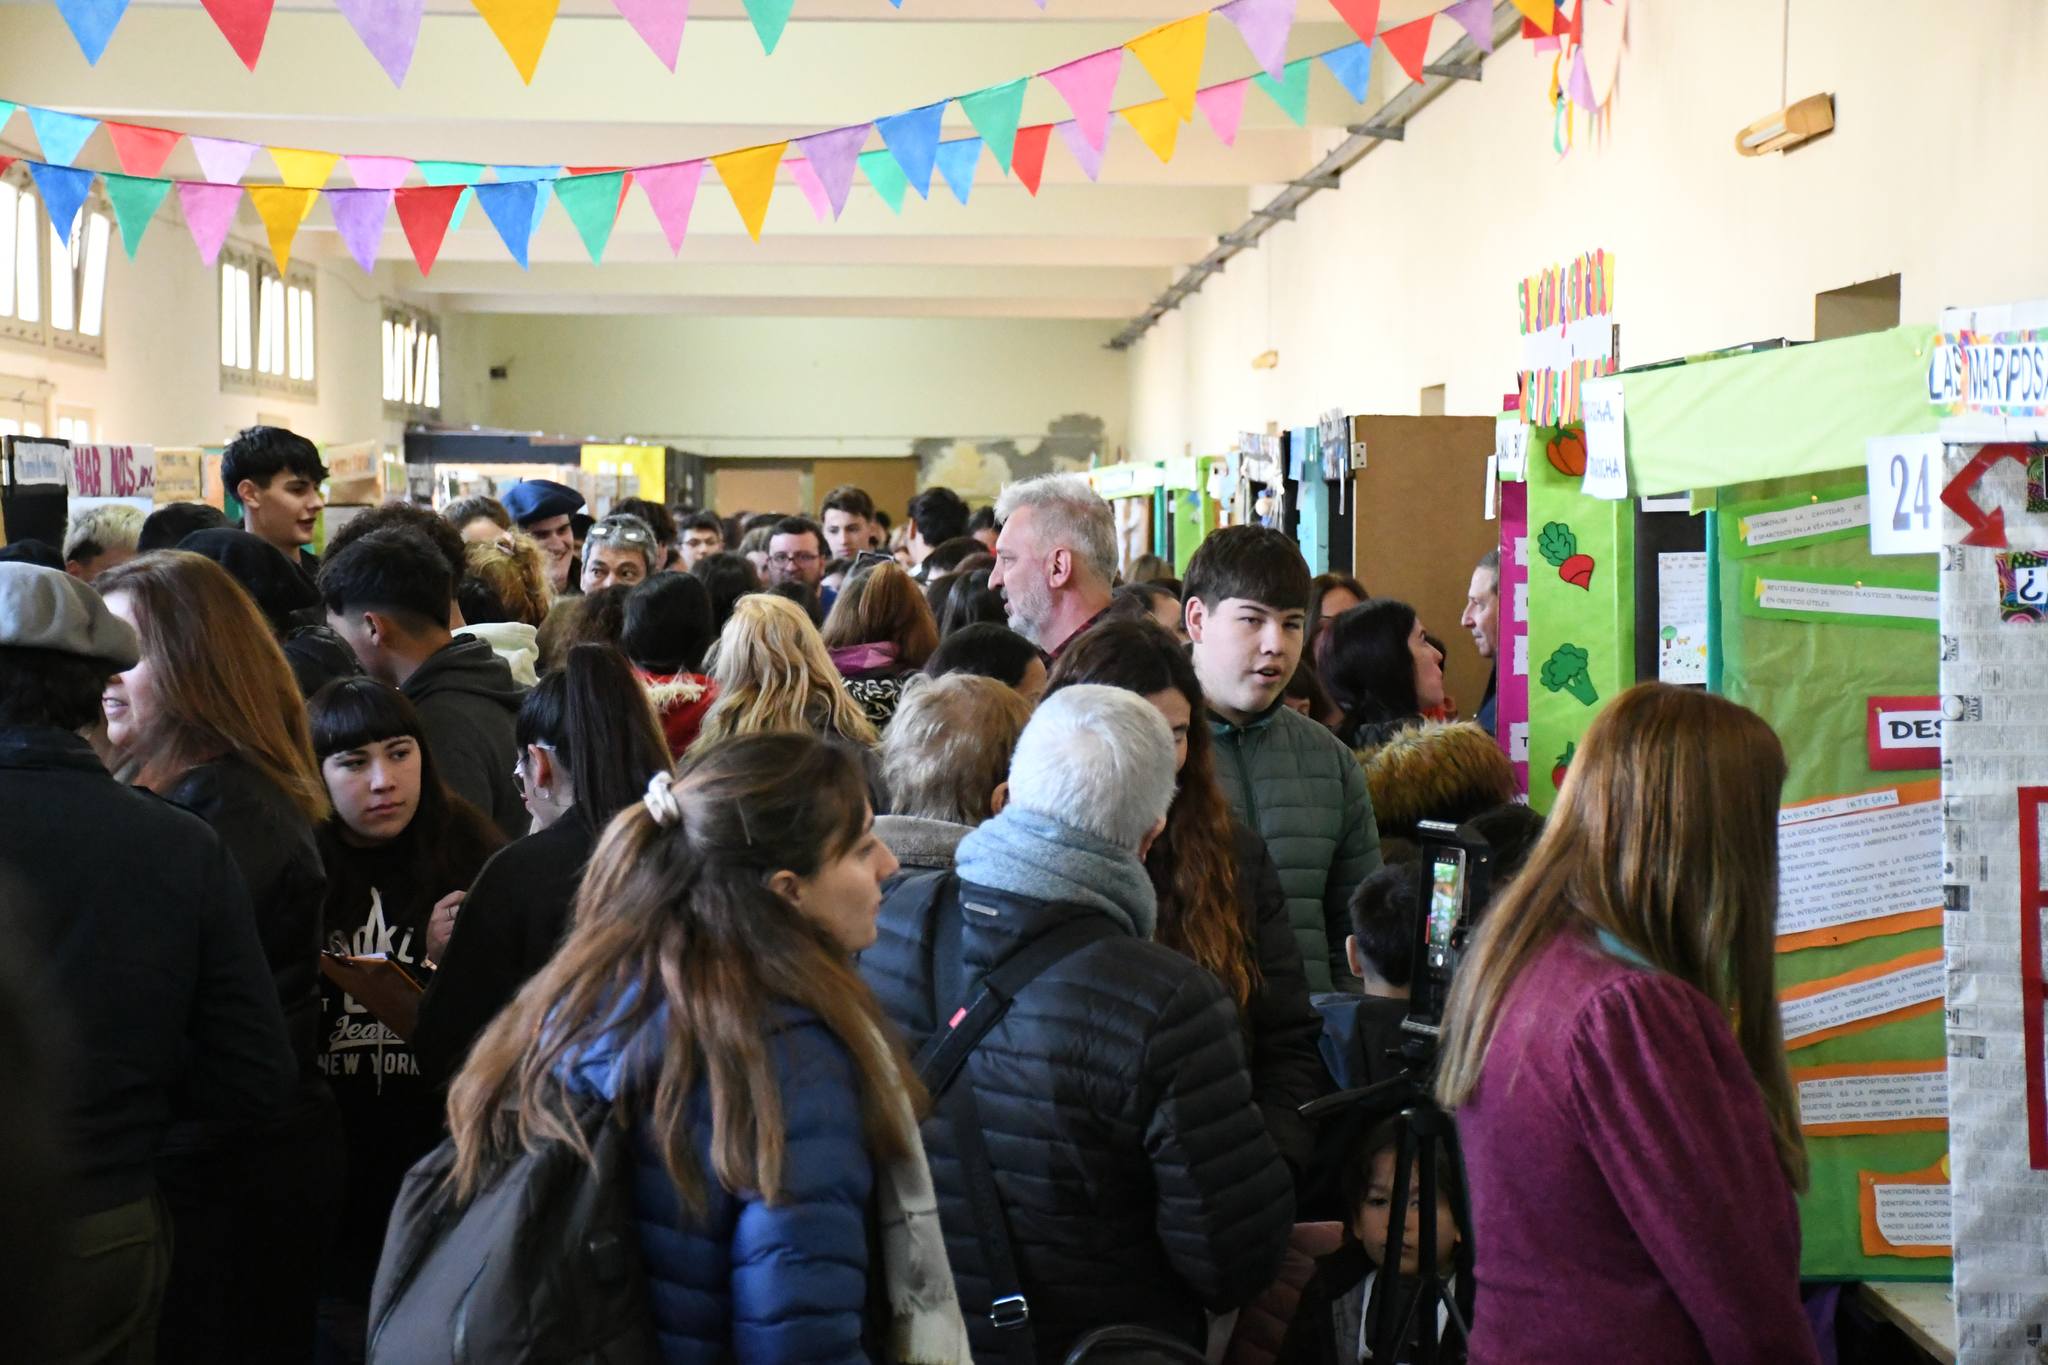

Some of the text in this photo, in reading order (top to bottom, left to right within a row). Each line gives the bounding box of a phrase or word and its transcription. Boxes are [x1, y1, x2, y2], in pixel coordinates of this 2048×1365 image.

[1928, 344, 1962, 400] LAS
[1890, 453, 1931, 531] 24
[1846, 793, 1896, 809] INTEGRAL
